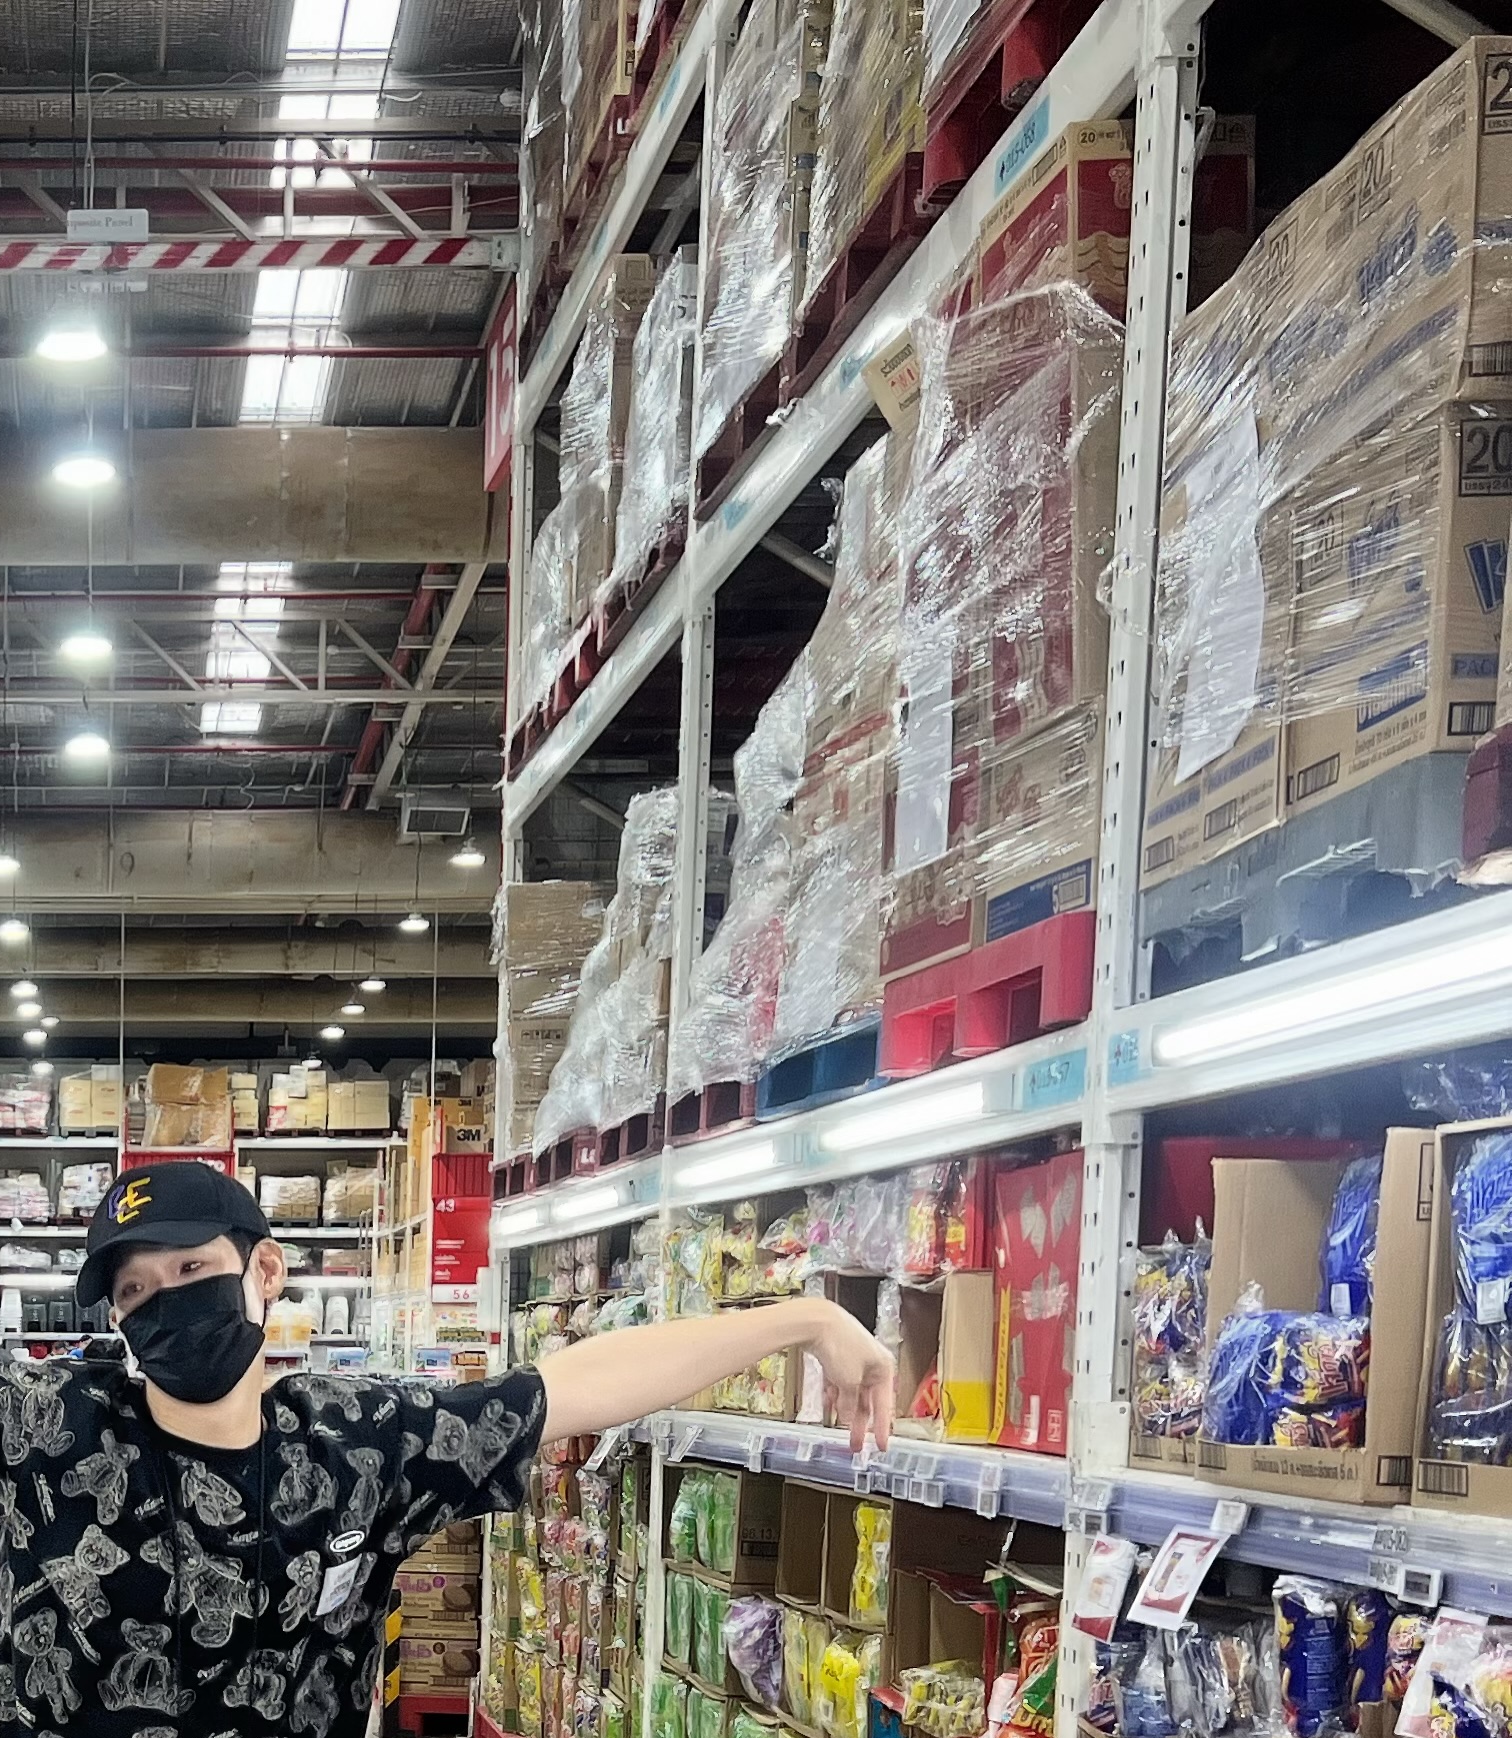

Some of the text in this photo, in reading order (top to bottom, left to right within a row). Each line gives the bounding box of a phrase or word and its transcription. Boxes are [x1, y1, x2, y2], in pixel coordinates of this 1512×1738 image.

[1080, 131, 1096, 144] 20
[1466, 424, 1512, 474] 20
[456, 1128, 481, 1142] 3M
[435, 1198, 456, 1213] 43
[453, 1289, 470, 1300] 56
